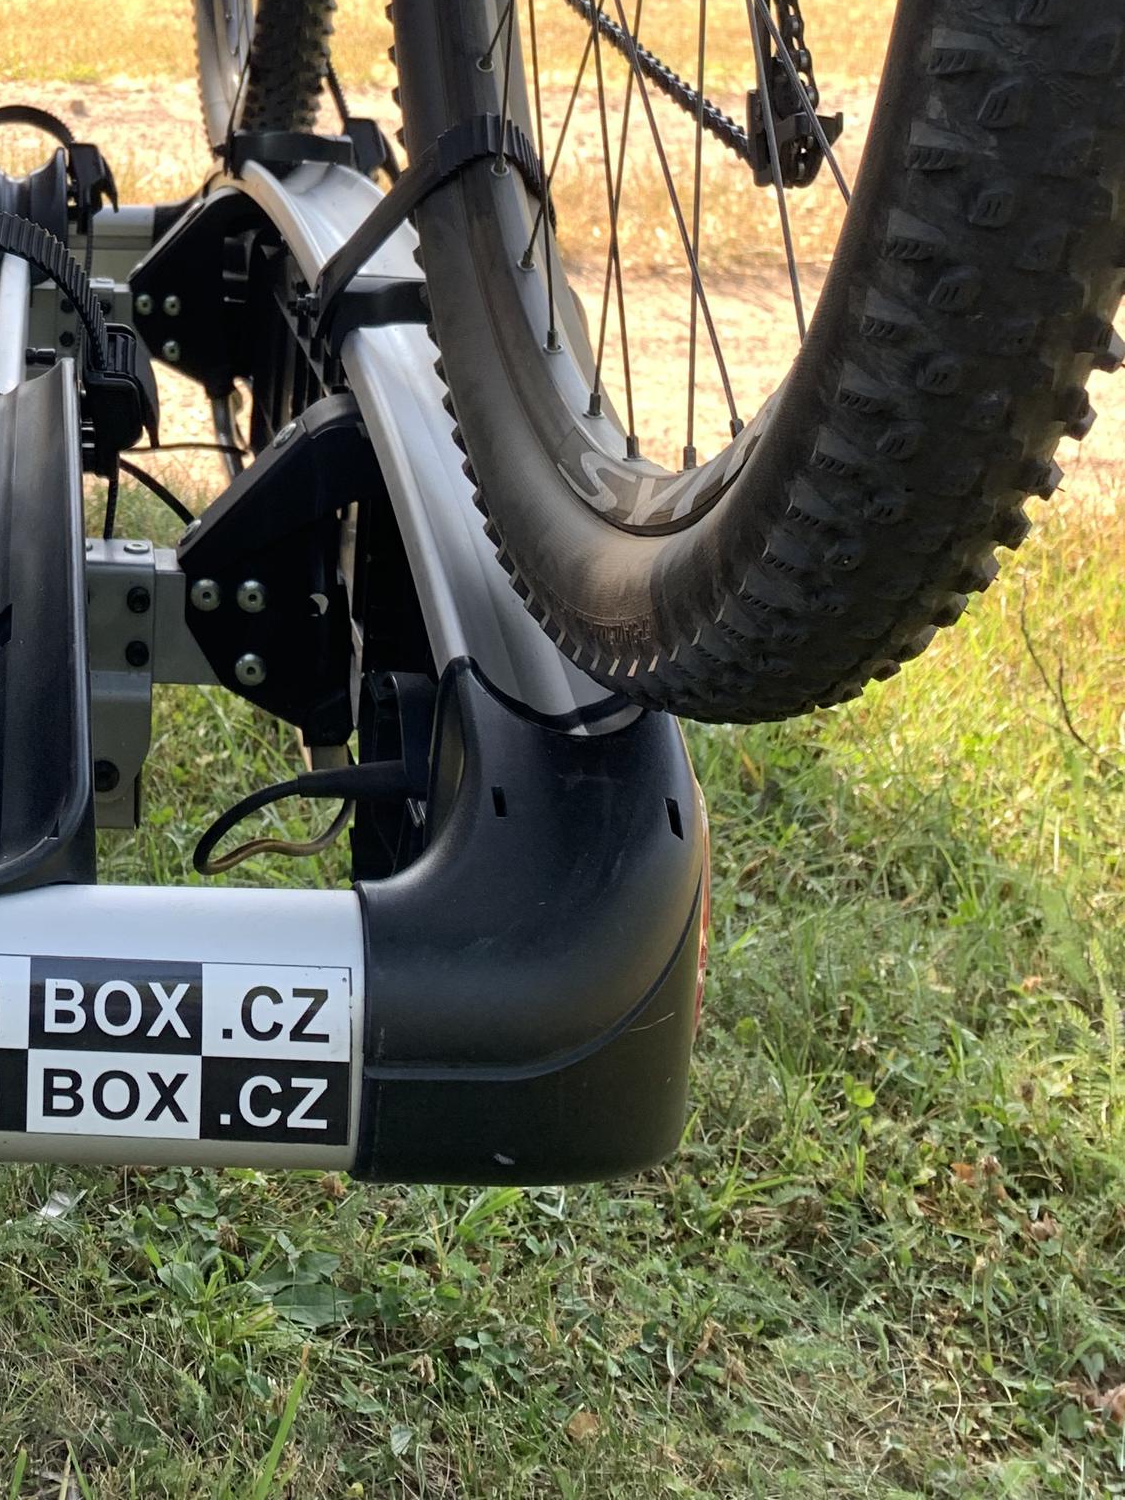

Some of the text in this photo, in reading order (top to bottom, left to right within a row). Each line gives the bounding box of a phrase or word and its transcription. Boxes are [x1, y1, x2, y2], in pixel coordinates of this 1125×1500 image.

[43, 978, 191, 1040] BOX
[221, 986, 330, 1043] .CZ
[43, 1068, 188, 1123] BOX
[219, 1076, 329, 1130] .CZ
